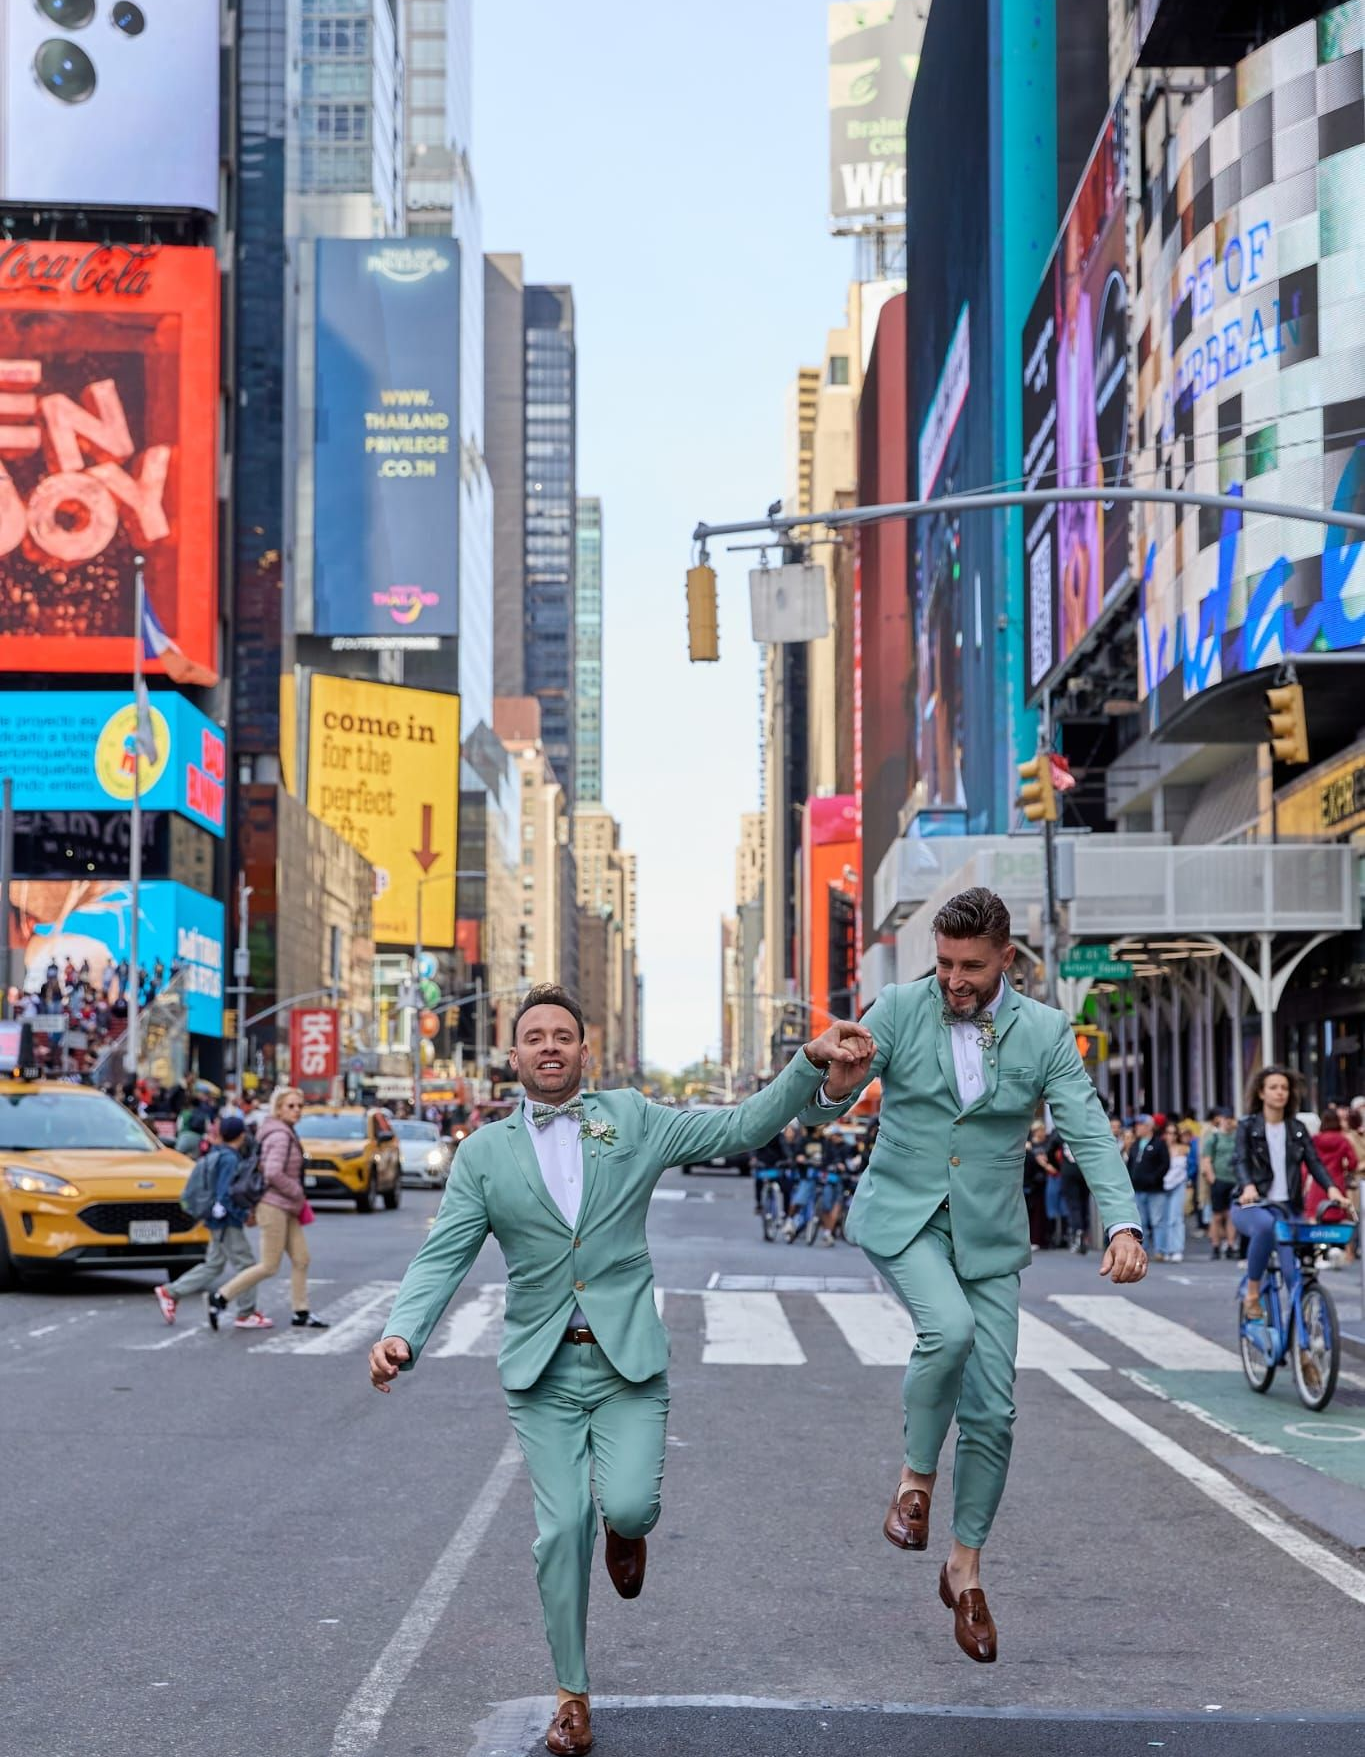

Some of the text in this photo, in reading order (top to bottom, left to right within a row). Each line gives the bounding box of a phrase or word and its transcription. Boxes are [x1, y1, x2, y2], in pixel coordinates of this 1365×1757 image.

[1223, 220, 1272, 295] OF
[364, 412, 449, 430] THAILAND
[365, 436, 449, 453] PRIVILEGE
[323, 711, 436, 744] come in
[321, 735, 392, 775] for the
[319, 780, 397, 817] perfect
[301, 1010, 333, 1075] tkts
